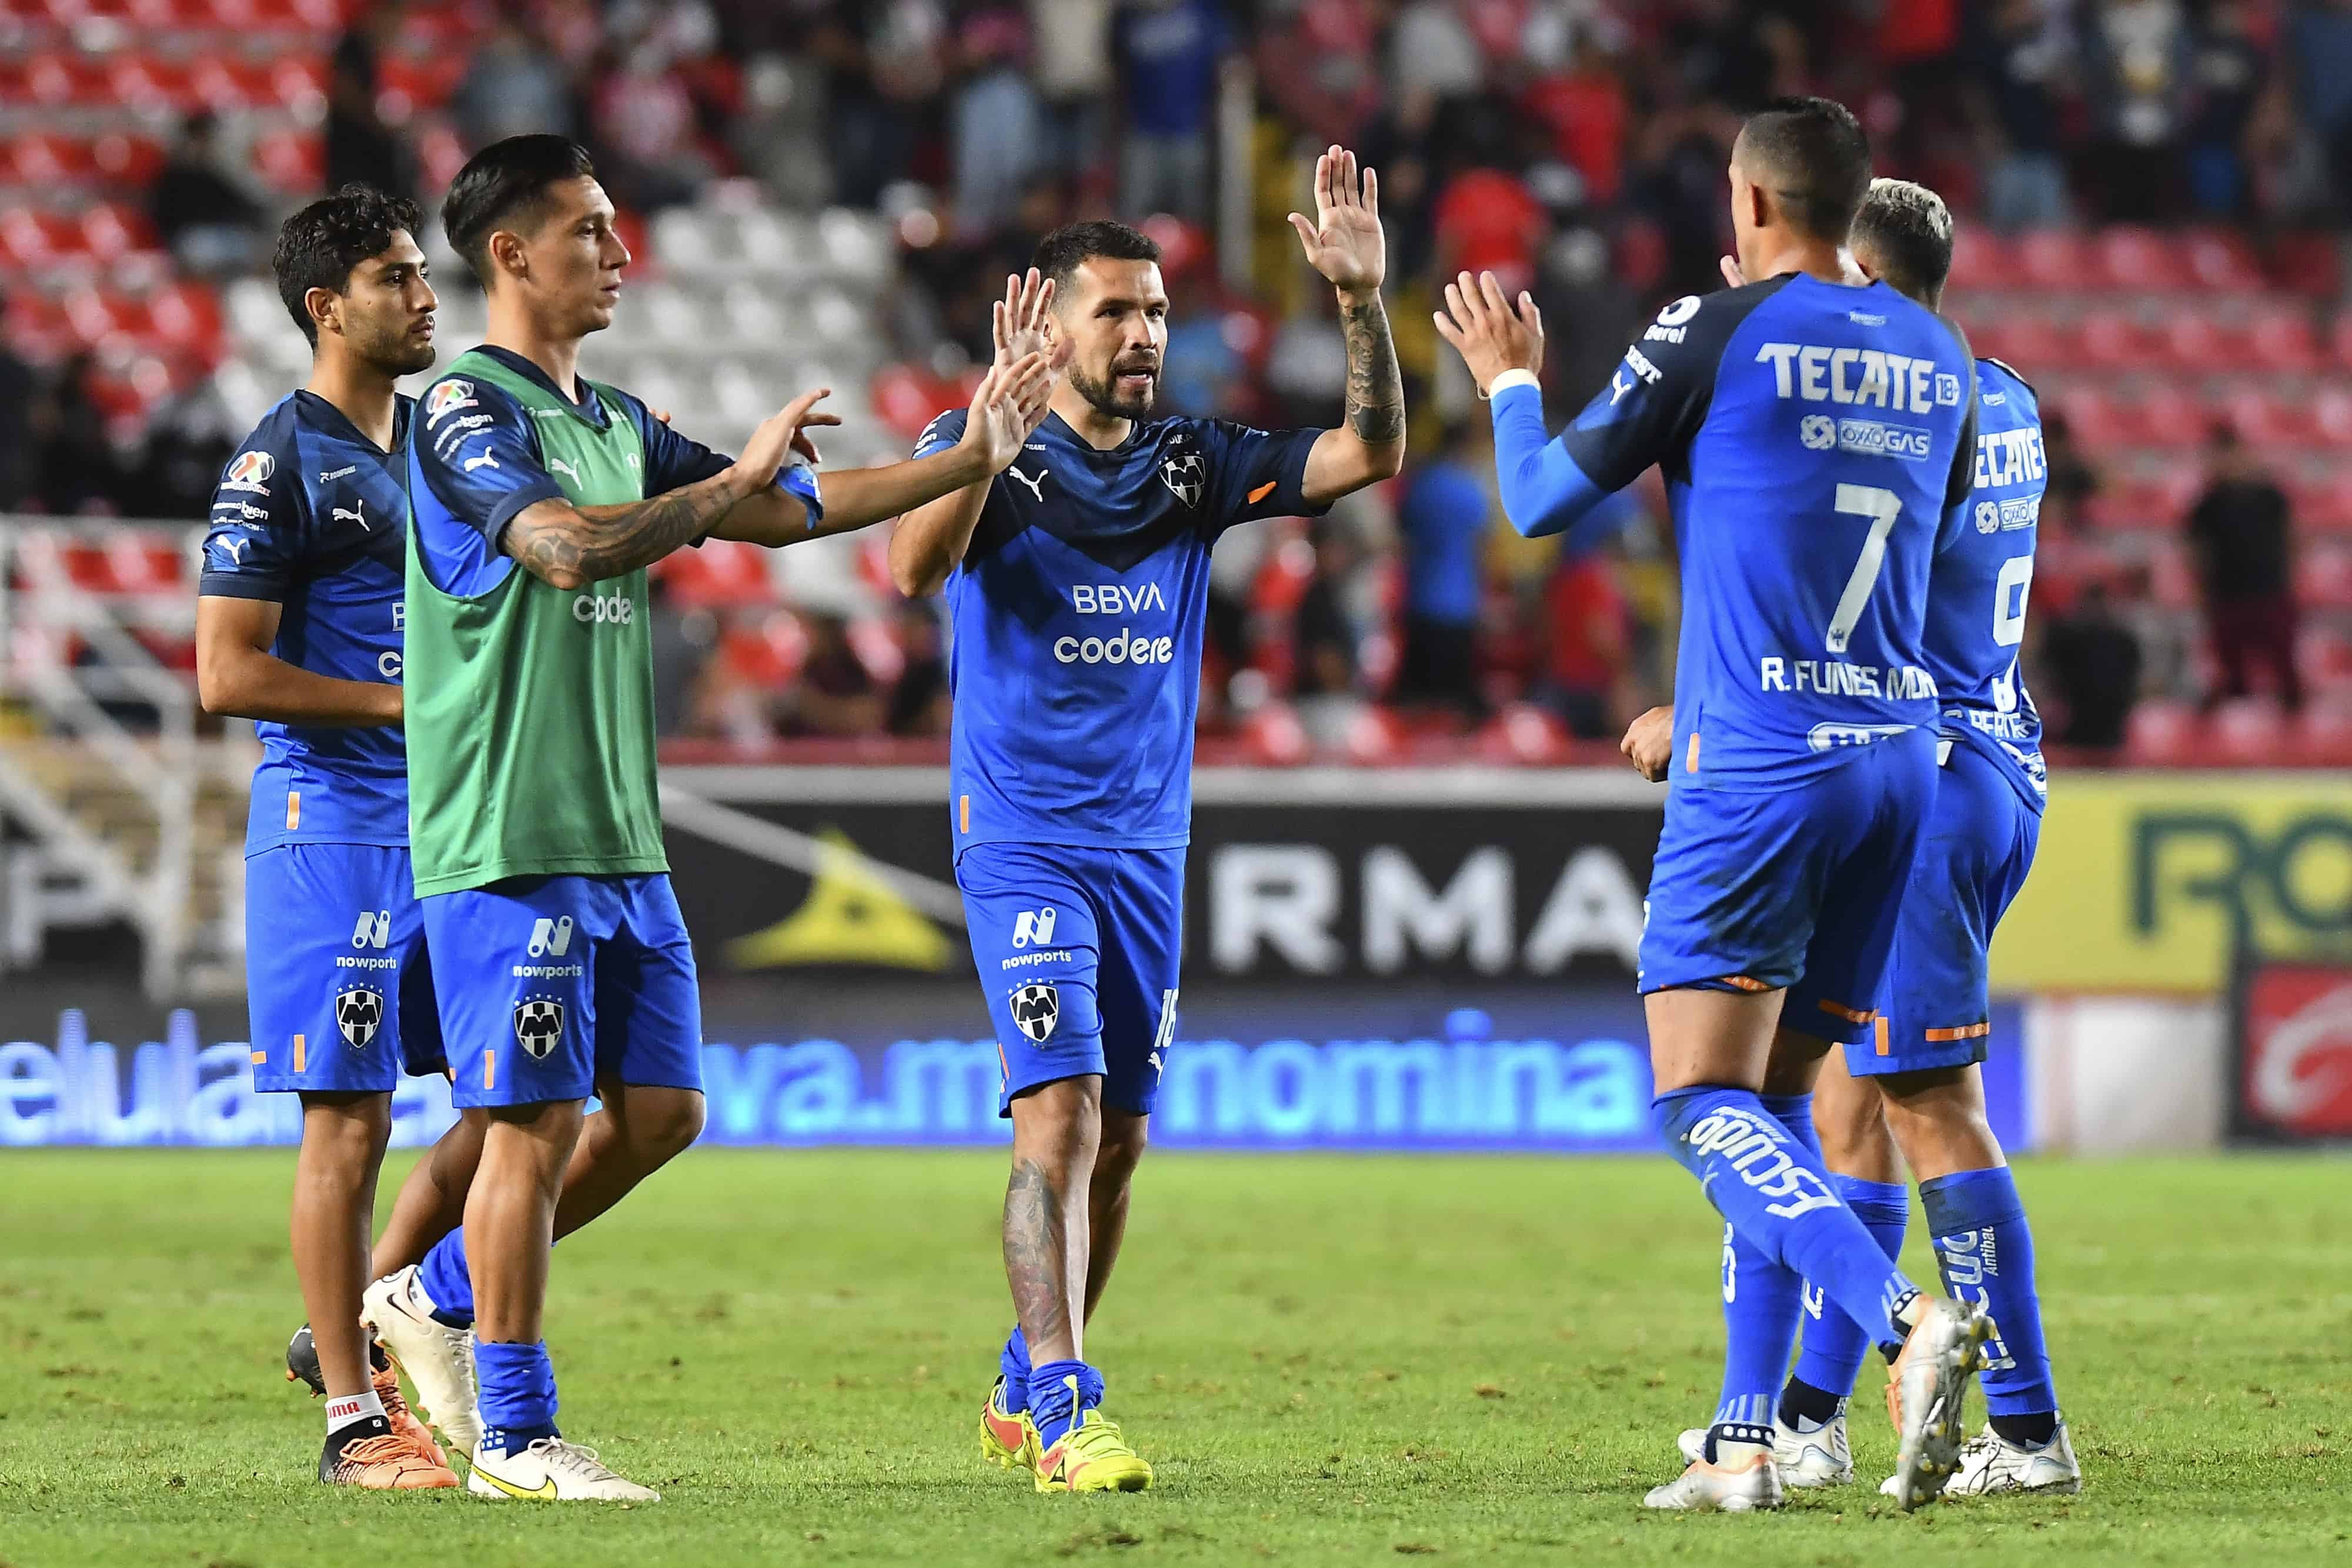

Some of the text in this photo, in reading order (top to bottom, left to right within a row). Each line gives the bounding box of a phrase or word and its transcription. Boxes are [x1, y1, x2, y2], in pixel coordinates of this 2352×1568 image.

[1755, 342, 1936, 415] TECATE
[1973, 427, 2043, 489] ECATE
[241, 500, 269, 520] bien
[1826, 483, 1903, 654] 7
[1073, 582, 1166, 614] BBVA
[1053, 628, 1173, 664] codere
[336, 955, 397, 971] nowports
[513, 964, 583, 980] nowports
[1001, 949, 1073, 971] nowports
[1154, 988, 1180, 1048] 16
